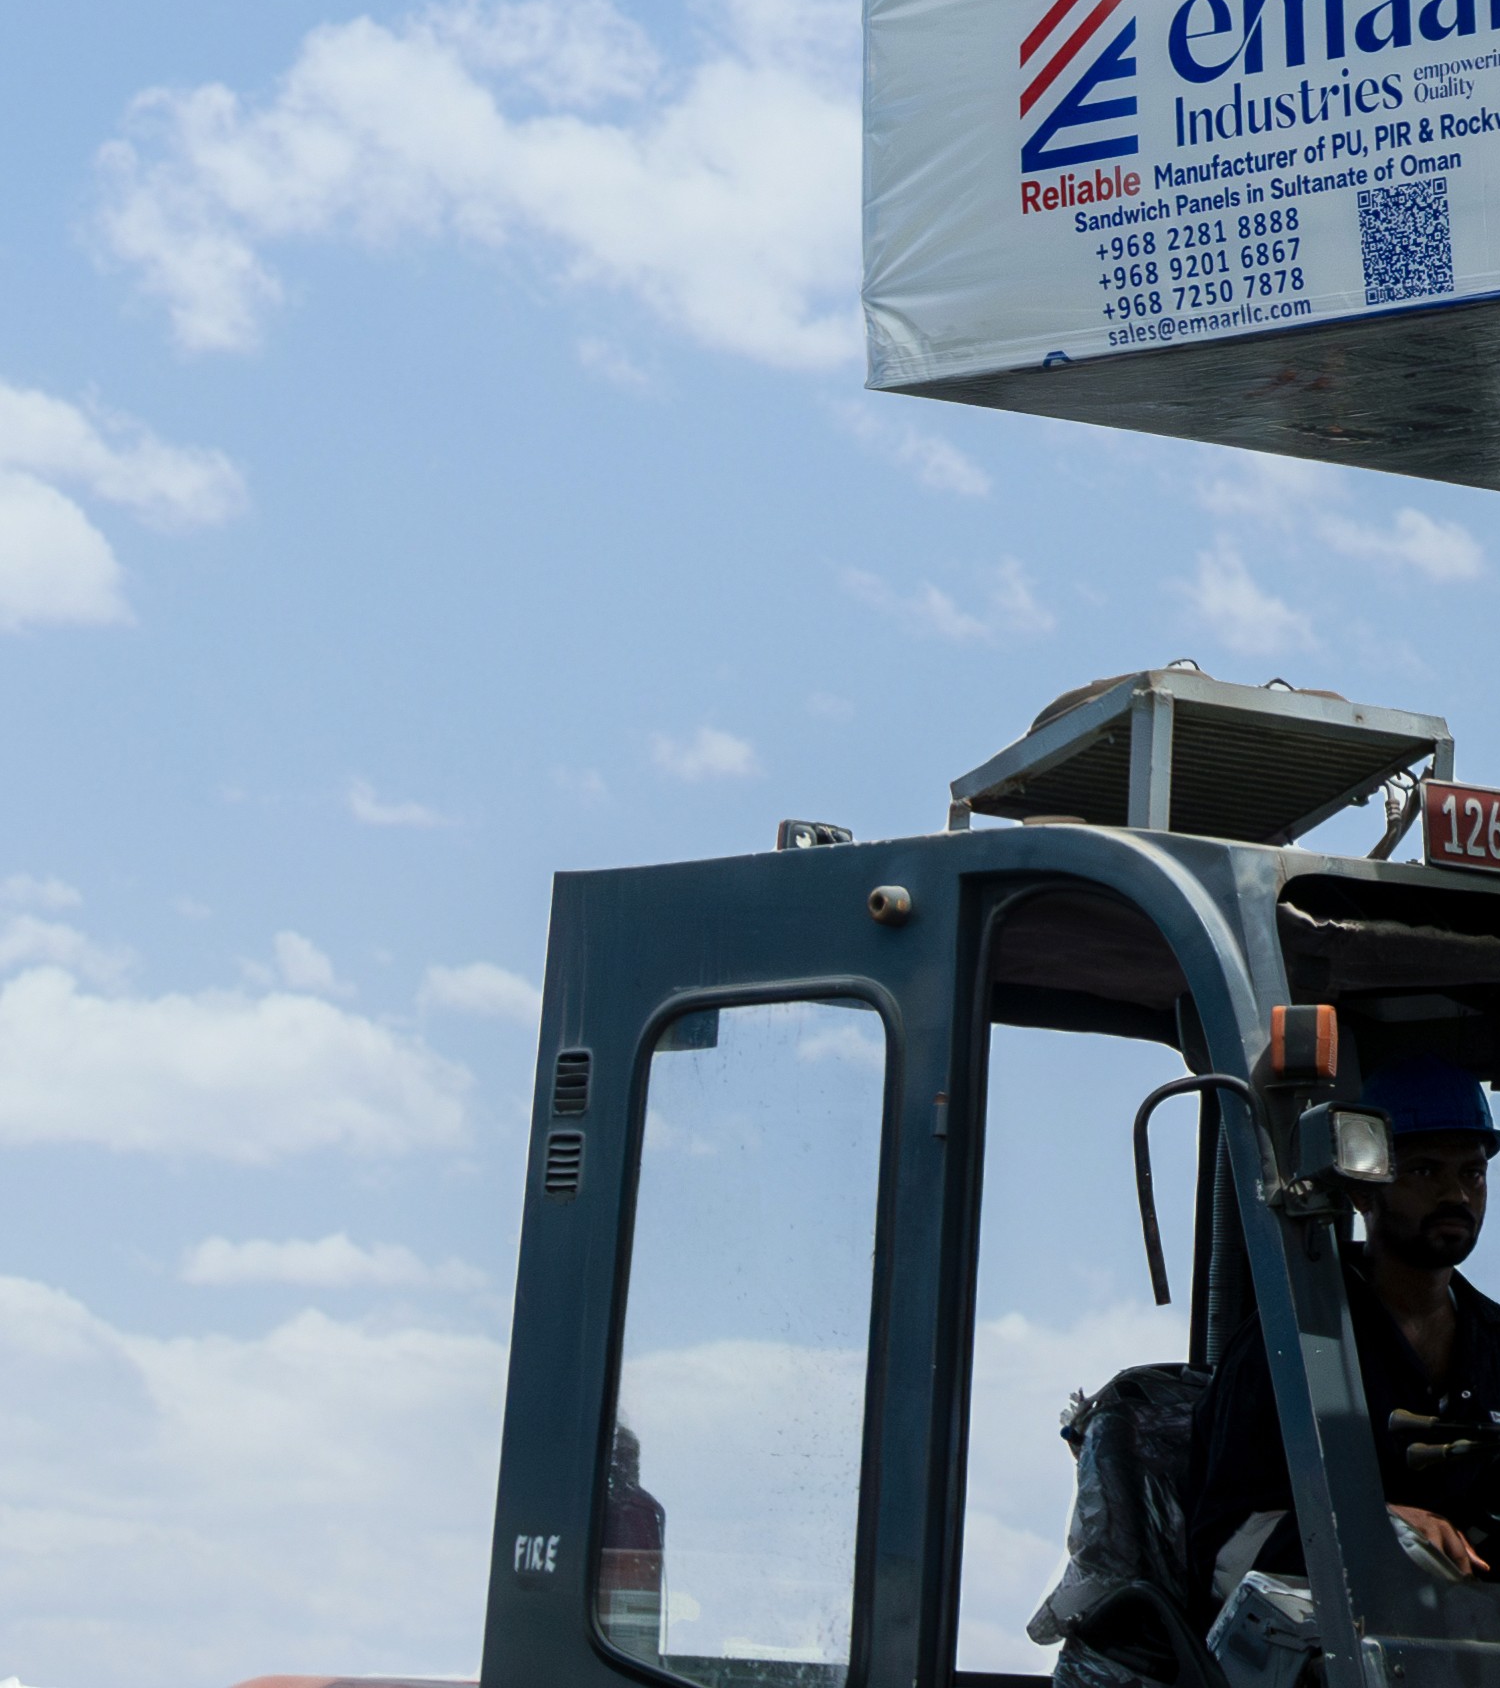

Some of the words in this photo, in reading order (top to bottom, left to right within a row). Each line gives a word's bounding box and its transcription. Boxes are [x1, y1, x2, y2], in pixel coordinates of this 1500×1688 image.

[1175, 68, 1403, 147] Industries
[1414, 76, 1475, 103] Quality
[1021, 165, 1140, 214] Reliable
[1154, 148, 1297, 190] Manufacturer
[1304, 136, 1326, 164] of
[1331, 129, 1368, 159] PU,
[1375, 121, 1412, 151] PIR
[1418, 118, 1434, 143] &
[1075, 198, 1170, 233] Sandwich
[1175, 187, 1240, 216] Panels
[1247, 187, 1264, 204] in
[1270, 167, 1368, 200] Sultanate
[1374, 157, 1394, 182] of
[1400, 153, 1461, 176] Oman
[1096, 232, 1156, 261] +968
[1167, 220, 1227, 251] 2281
[1238, 207, 1299, 239] 8888
[1099, 261, 1159, 290] +968
[1169, 250, 1230, 281] 9201
[1241, 237, 1300, 269] 6867
[1103, 291, 1162, 320] +968
[1172, 279, 1233, 310] 7250
[1243, 267, 1304, 298] 7878
[1108, 299, 1312, 346] sales@emaarllc.com
[513, 1534, 561, 1573] FIRE
